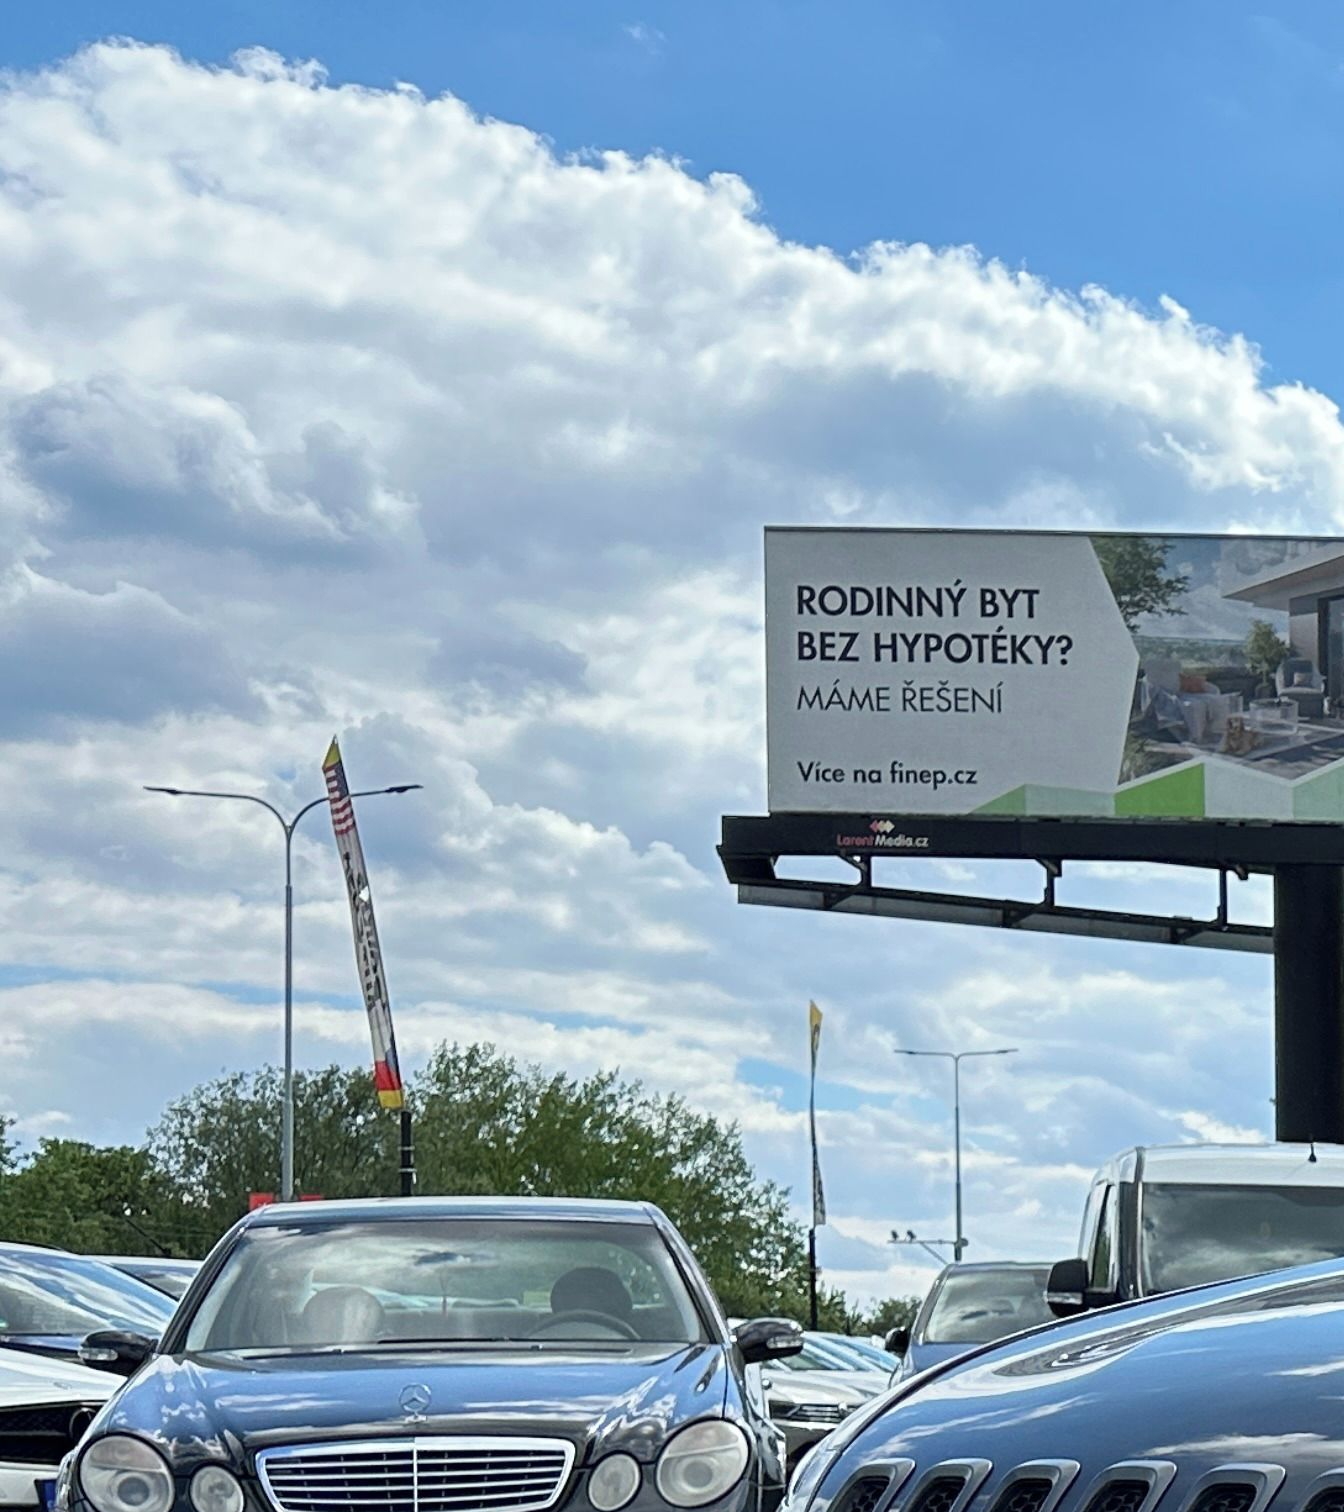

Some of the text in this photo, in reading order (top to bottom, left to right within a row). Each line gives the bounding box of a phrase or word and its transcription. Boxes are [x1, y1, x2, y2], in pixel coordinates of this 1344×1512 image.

[797, 578, 1041, 619] RODINNÝ BYT
[797, 625, 1074, 666] BEZ HYPOTÉKY?
[796, 678, 1004, 714] MÁME ŘEŠENÍ
[796, 760, 979, 791] Více na finep.cz
